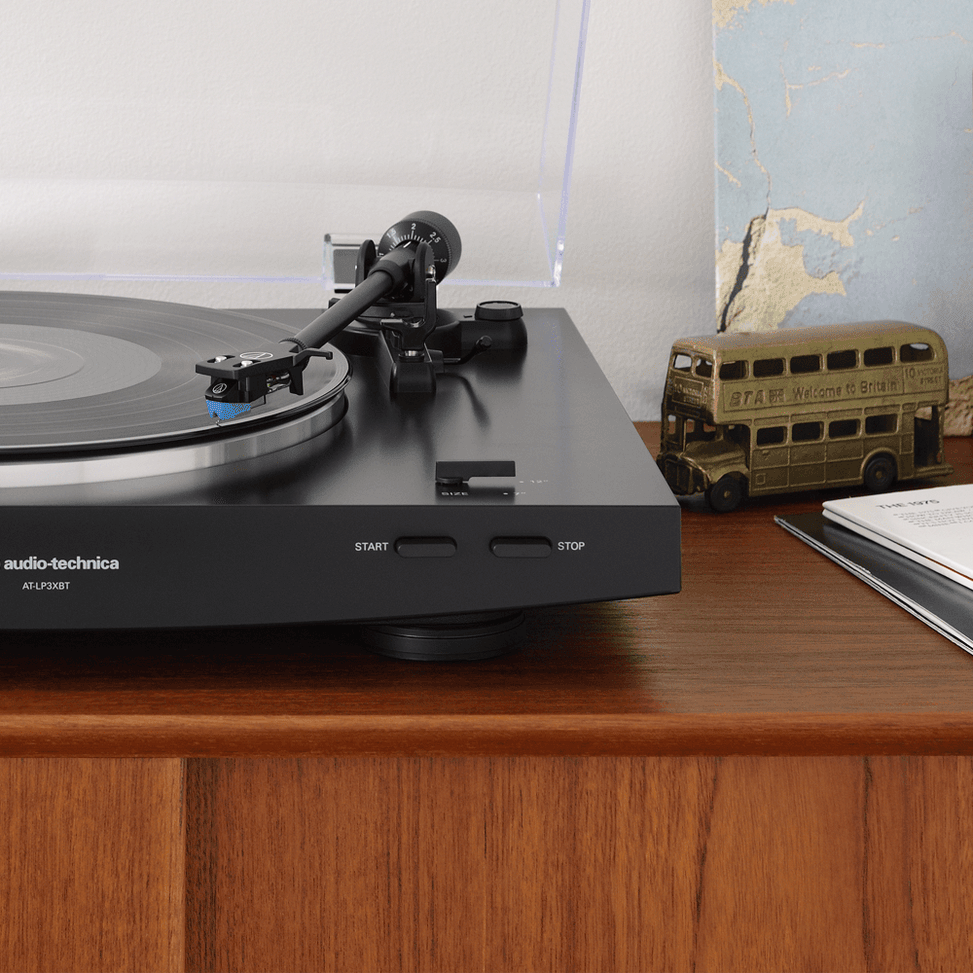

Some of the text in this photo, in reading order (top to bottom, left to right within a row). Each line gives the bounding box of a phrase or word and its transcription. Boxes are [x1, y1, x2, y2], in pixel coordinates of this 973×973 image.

[429, 231, 441, 243] 2.5
[905, 367, 916, 378] 10
[792, 385, 842, 400] Welcome
[845, 382, 856, 394] to
[860, 380, 899, 394] Britain
[354, 542, 389, 551] START
[557, 541, 585, 551] STOP
[3, 556, 120, 570] audio-technica
[22, 581, 70, 591] AT-LP3XBT
